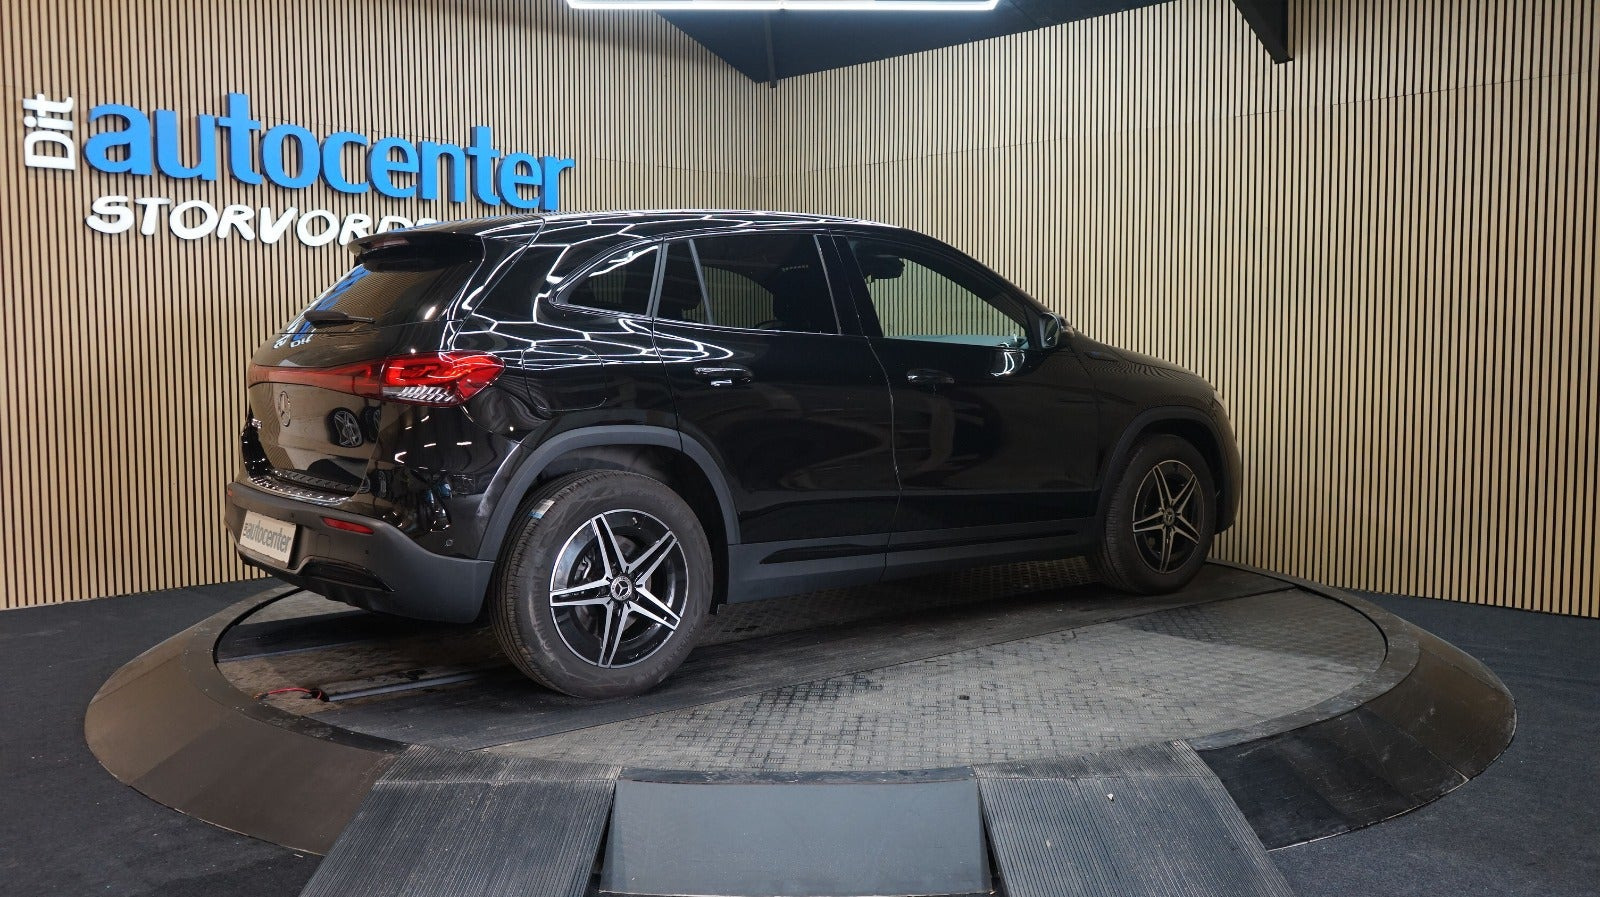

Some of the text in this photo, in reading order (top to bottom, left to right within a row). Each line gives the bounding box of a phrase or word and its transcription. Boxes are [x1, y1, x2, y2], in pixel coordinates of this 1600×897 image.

[23, 92, 576, 211] Dit autocenter
[86, 195, 438, 247] STORVOR
[245, 520, 292, 554] autocenter
